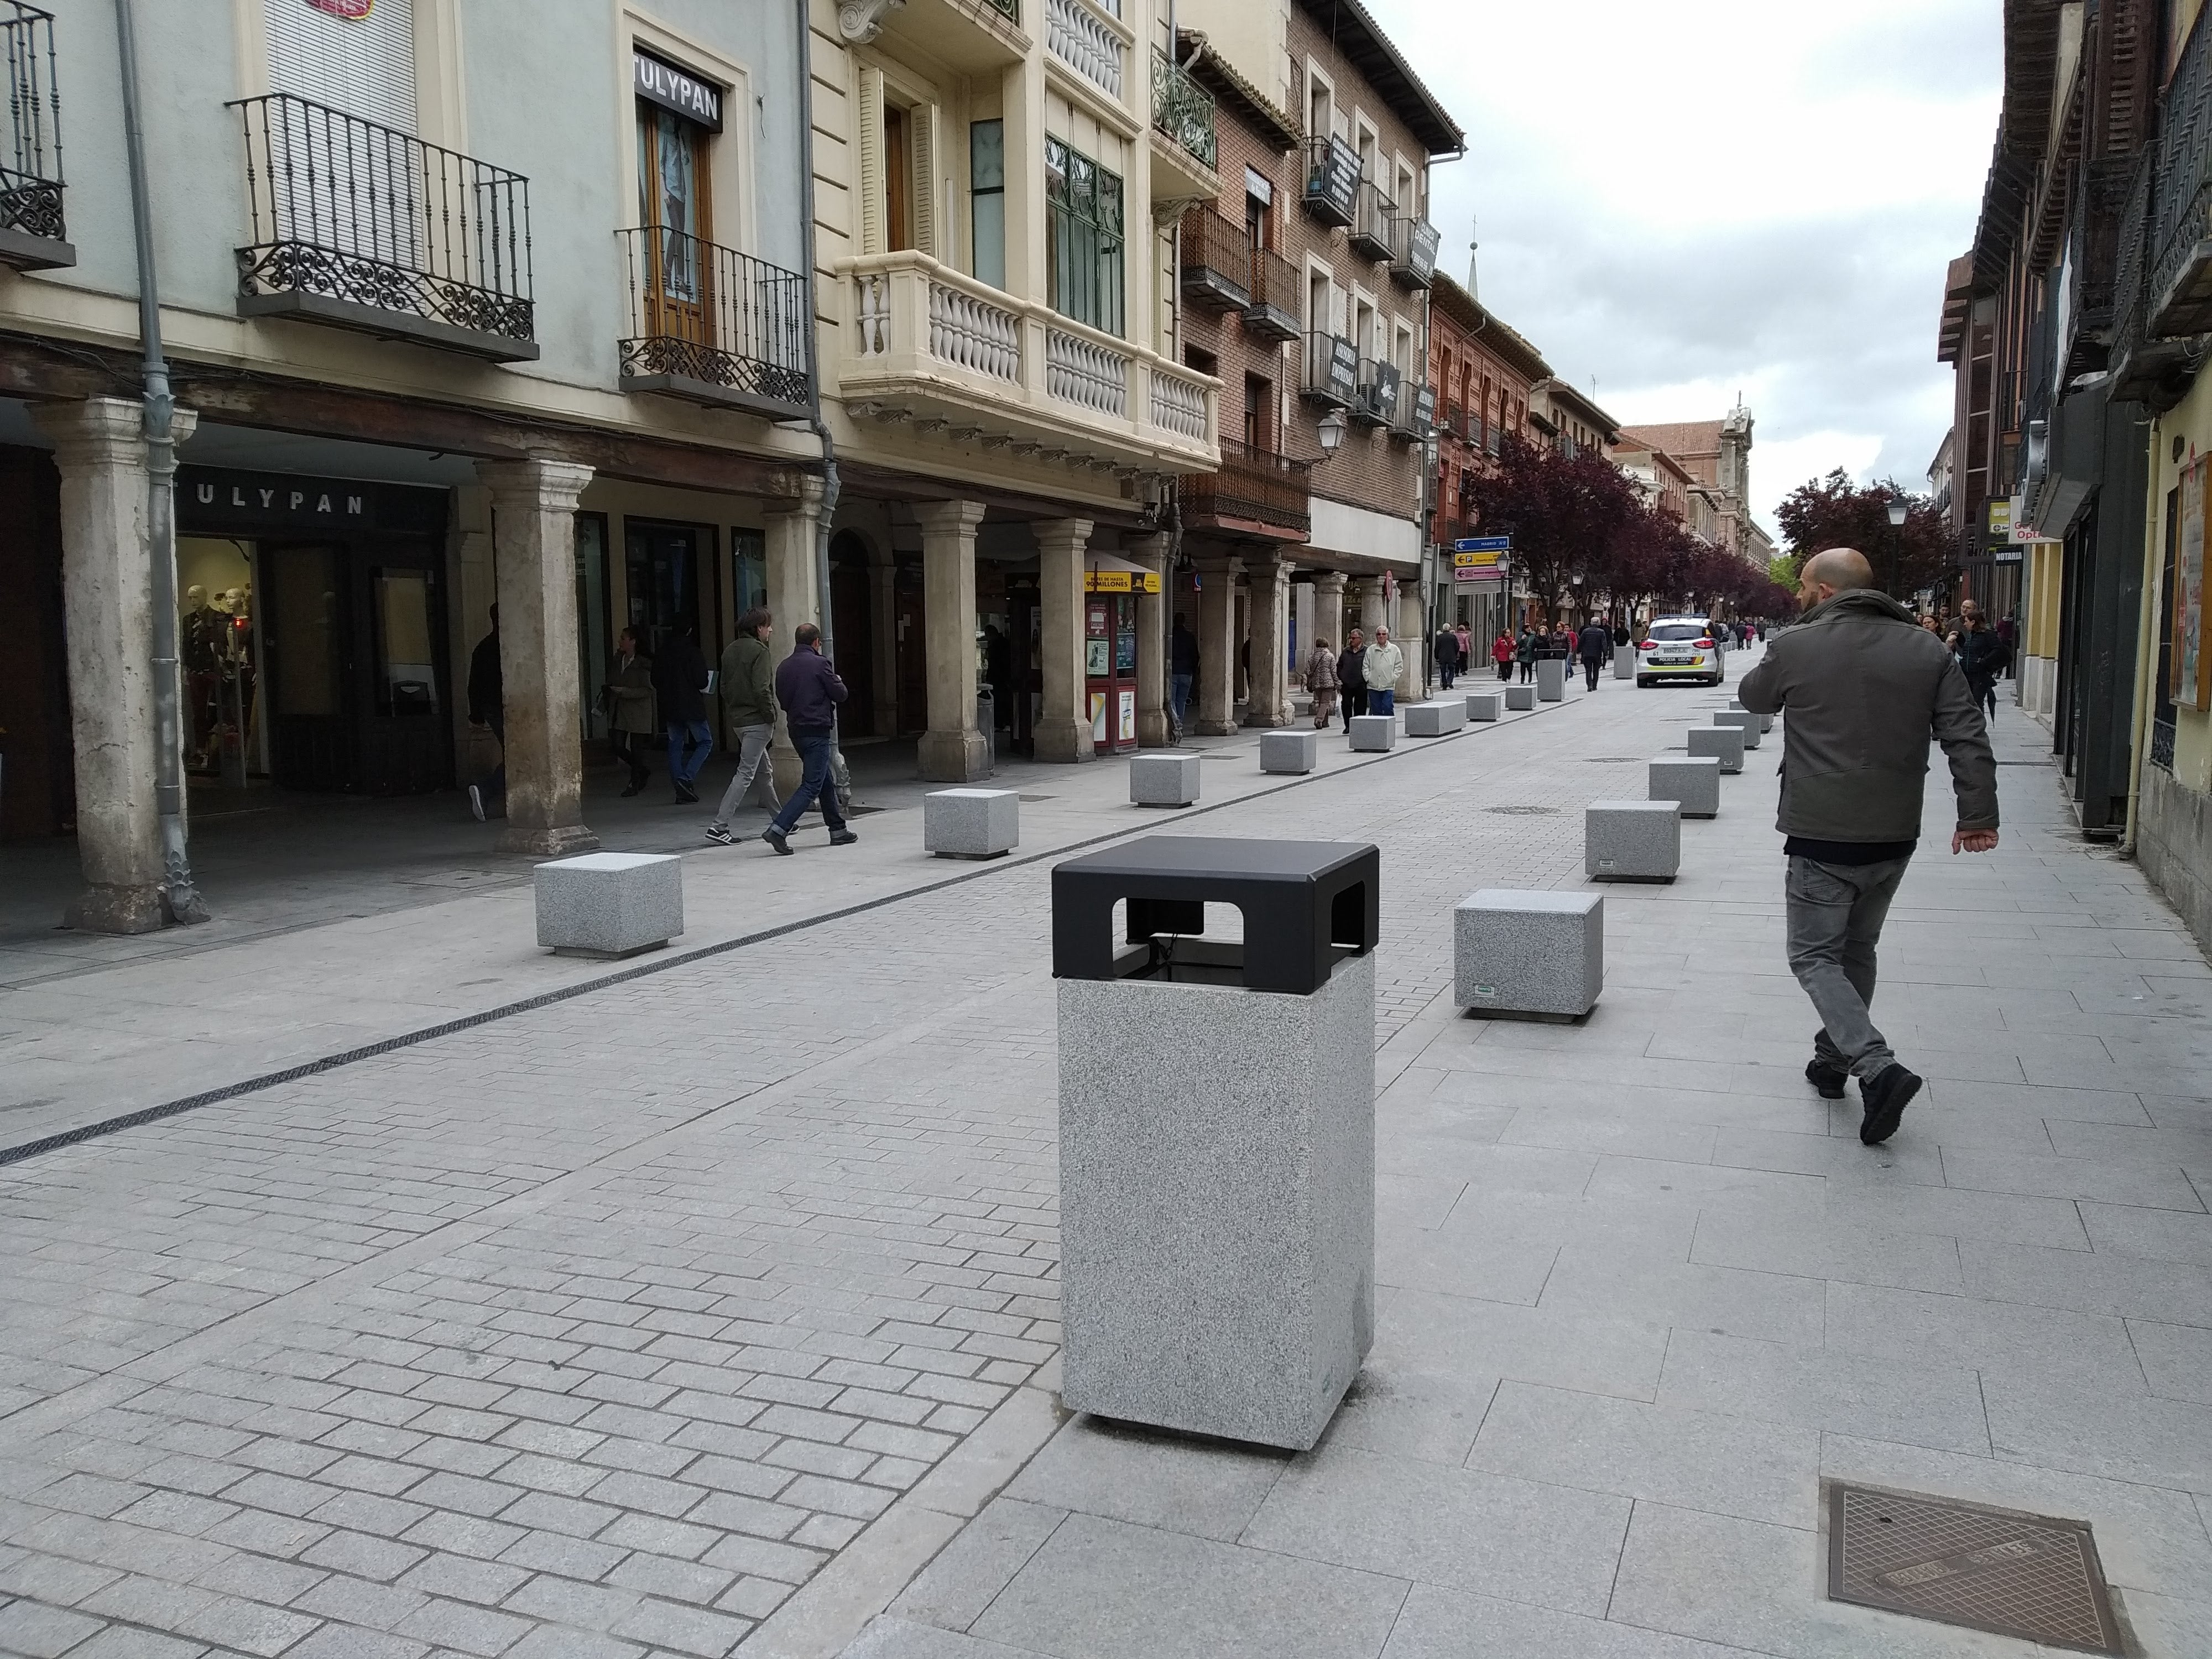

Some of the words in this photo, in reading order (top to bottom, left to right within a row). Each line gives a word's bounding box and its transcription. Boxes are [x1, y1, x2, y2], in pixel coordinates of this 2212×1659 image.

[1415, 229, 1436, 255] DENTAL
[1335, 341, 1356, 366] ASESORIA
[1331, 361, 1354, 387] EMPRESAS
[1996, 552, 2022, 561] NOTARIA
